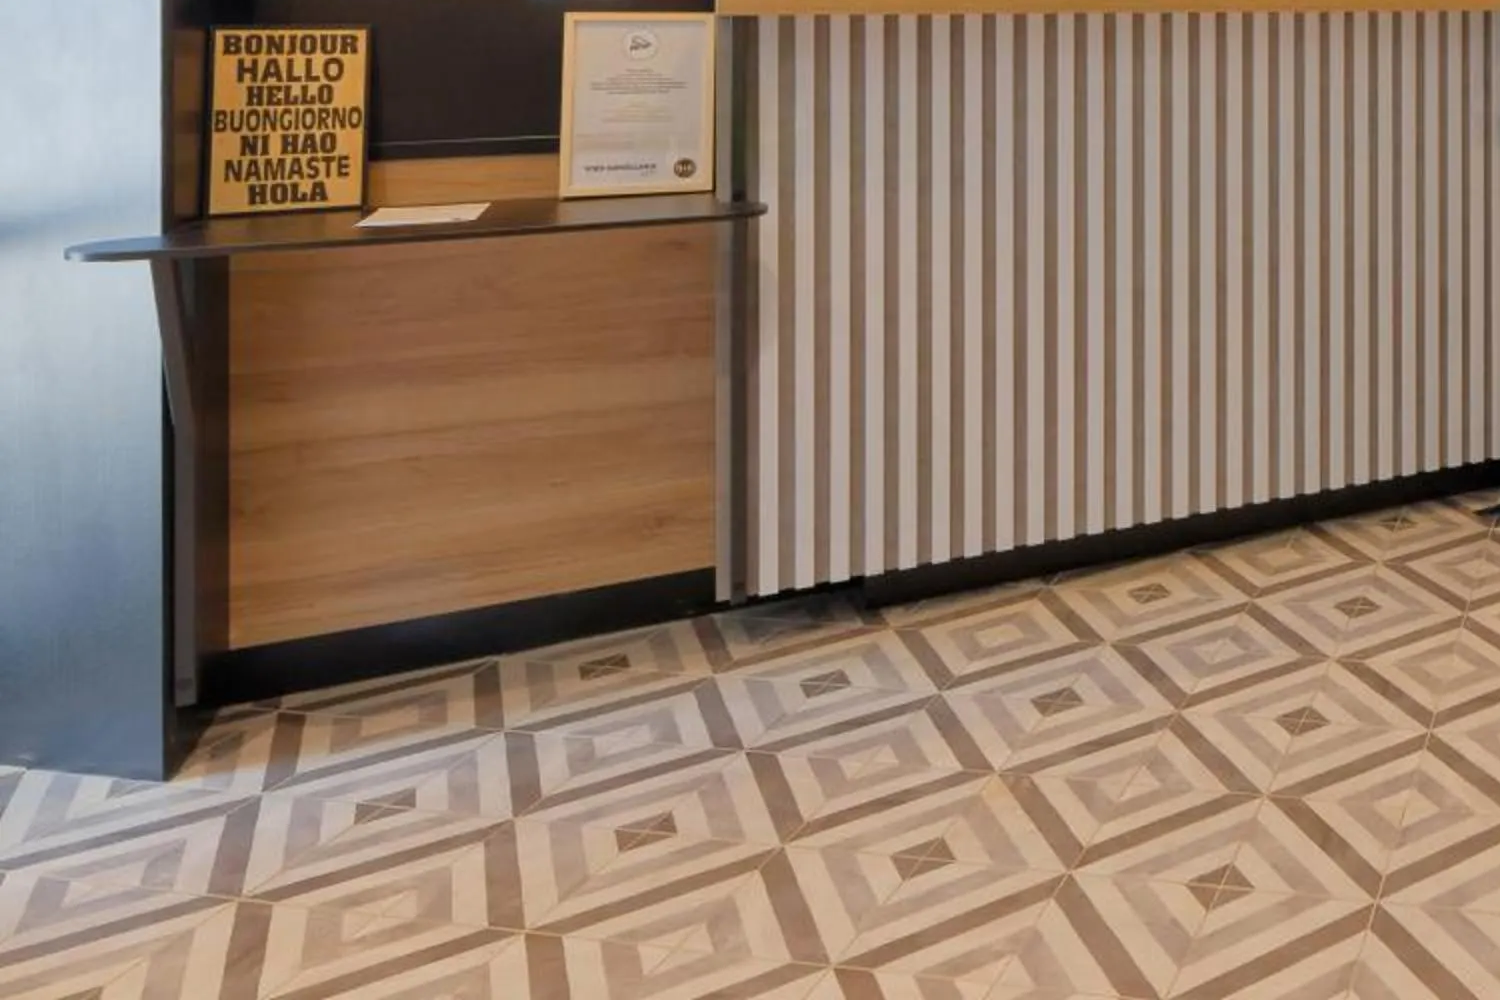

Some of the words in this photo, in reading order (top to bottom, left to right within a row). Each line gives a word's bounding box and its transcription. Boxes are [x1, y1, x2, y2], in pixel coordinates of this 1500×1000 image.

[222, 34, 358, 55] BONJOUR
[237, 57, 344, 82] HALLO
[246, 84, 334, 107] HELLO
[214, 106, 363, 132] BUONGIORNO
[240, 134, 270, 157] NI
[281, 132, 337, 155] HAO
[224, 156, 350, 182] NAMASTE
[248, 181, 328, 205] HOLA
